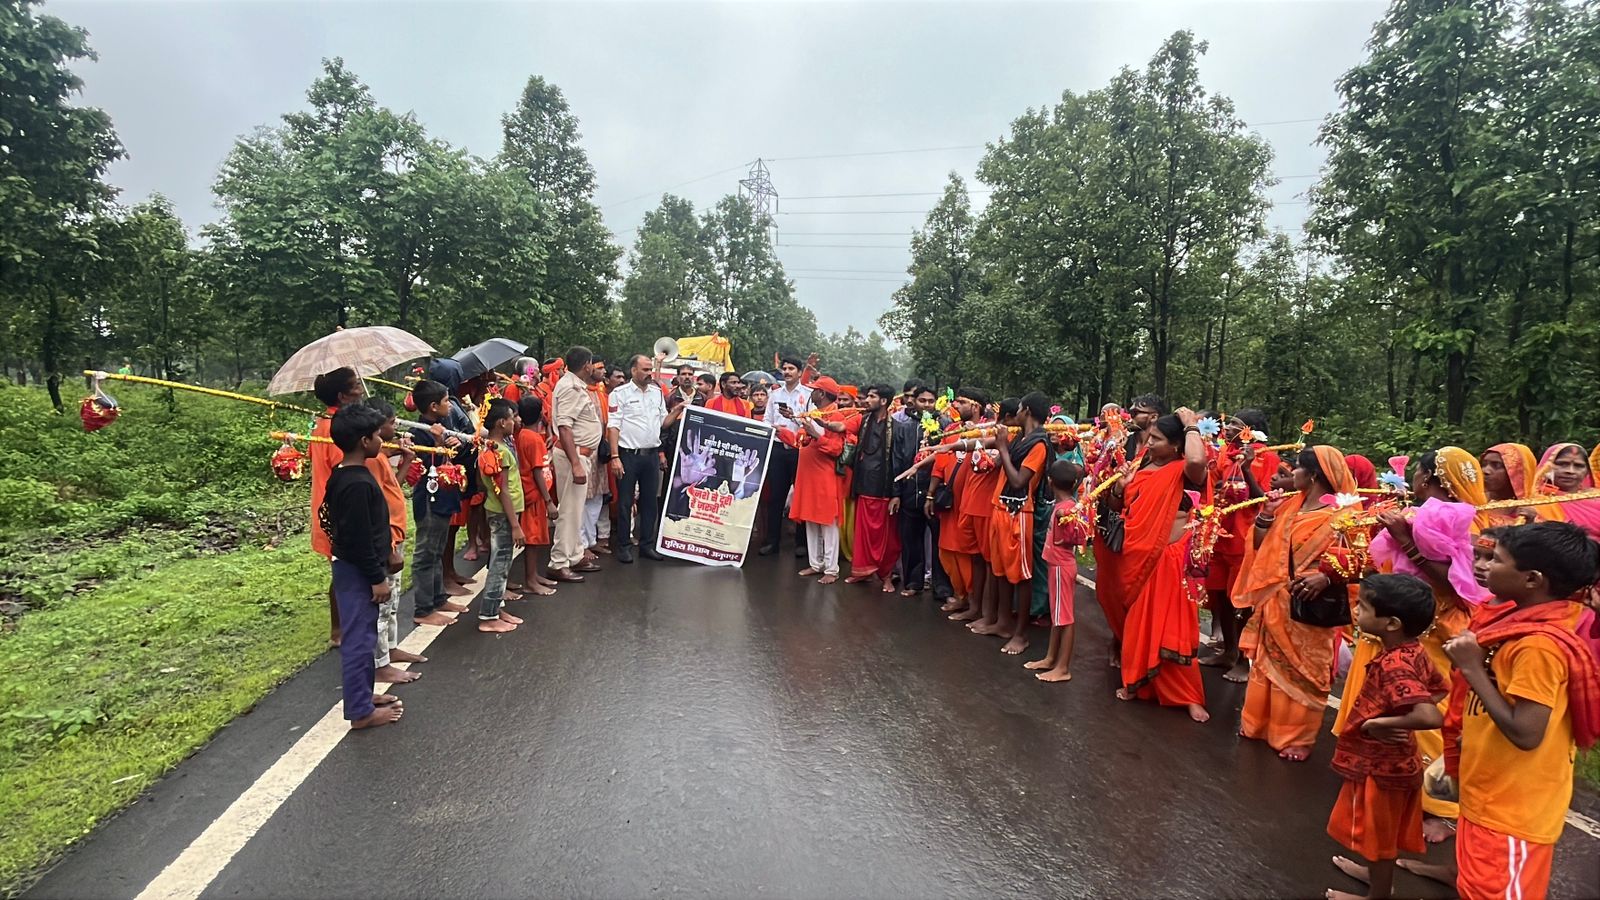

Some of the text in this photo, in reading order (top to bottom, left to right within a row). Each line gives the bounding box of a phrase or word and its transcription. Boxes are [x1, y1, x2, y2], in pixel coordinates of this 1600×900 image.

[711, 491, 718, 502] से
[719, 494, 733, 508] दूरी
[664, 540, 686, 551] पुलिस
[687, 544, 710, 555] विभाग
